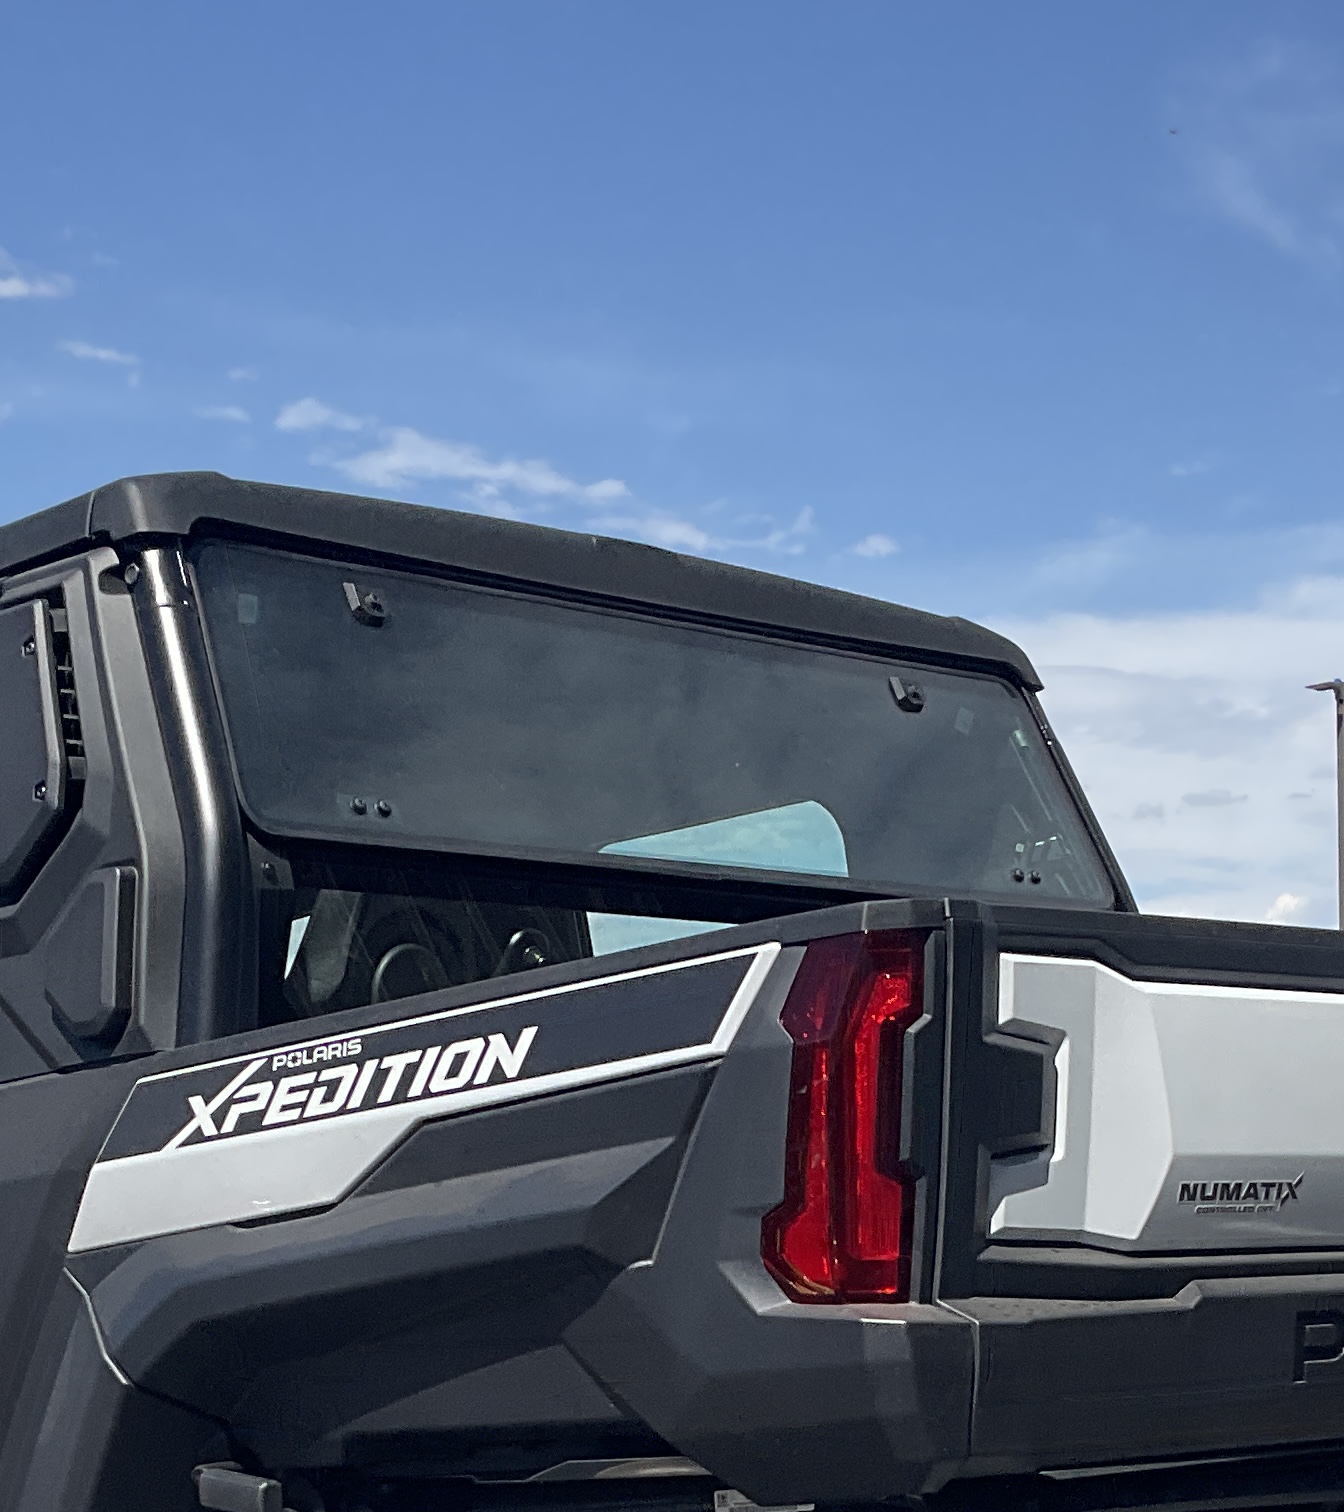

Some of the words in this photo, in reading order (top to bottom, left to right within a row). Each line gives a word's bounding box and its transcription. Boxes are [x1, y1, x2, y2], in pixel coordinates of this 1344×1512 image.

[271, 1037, 363, 1072] POLARIS
[160, 1025, 539, 1150] XPEDITION
[1177, 1170, 1305, 1212] NUMATIX
